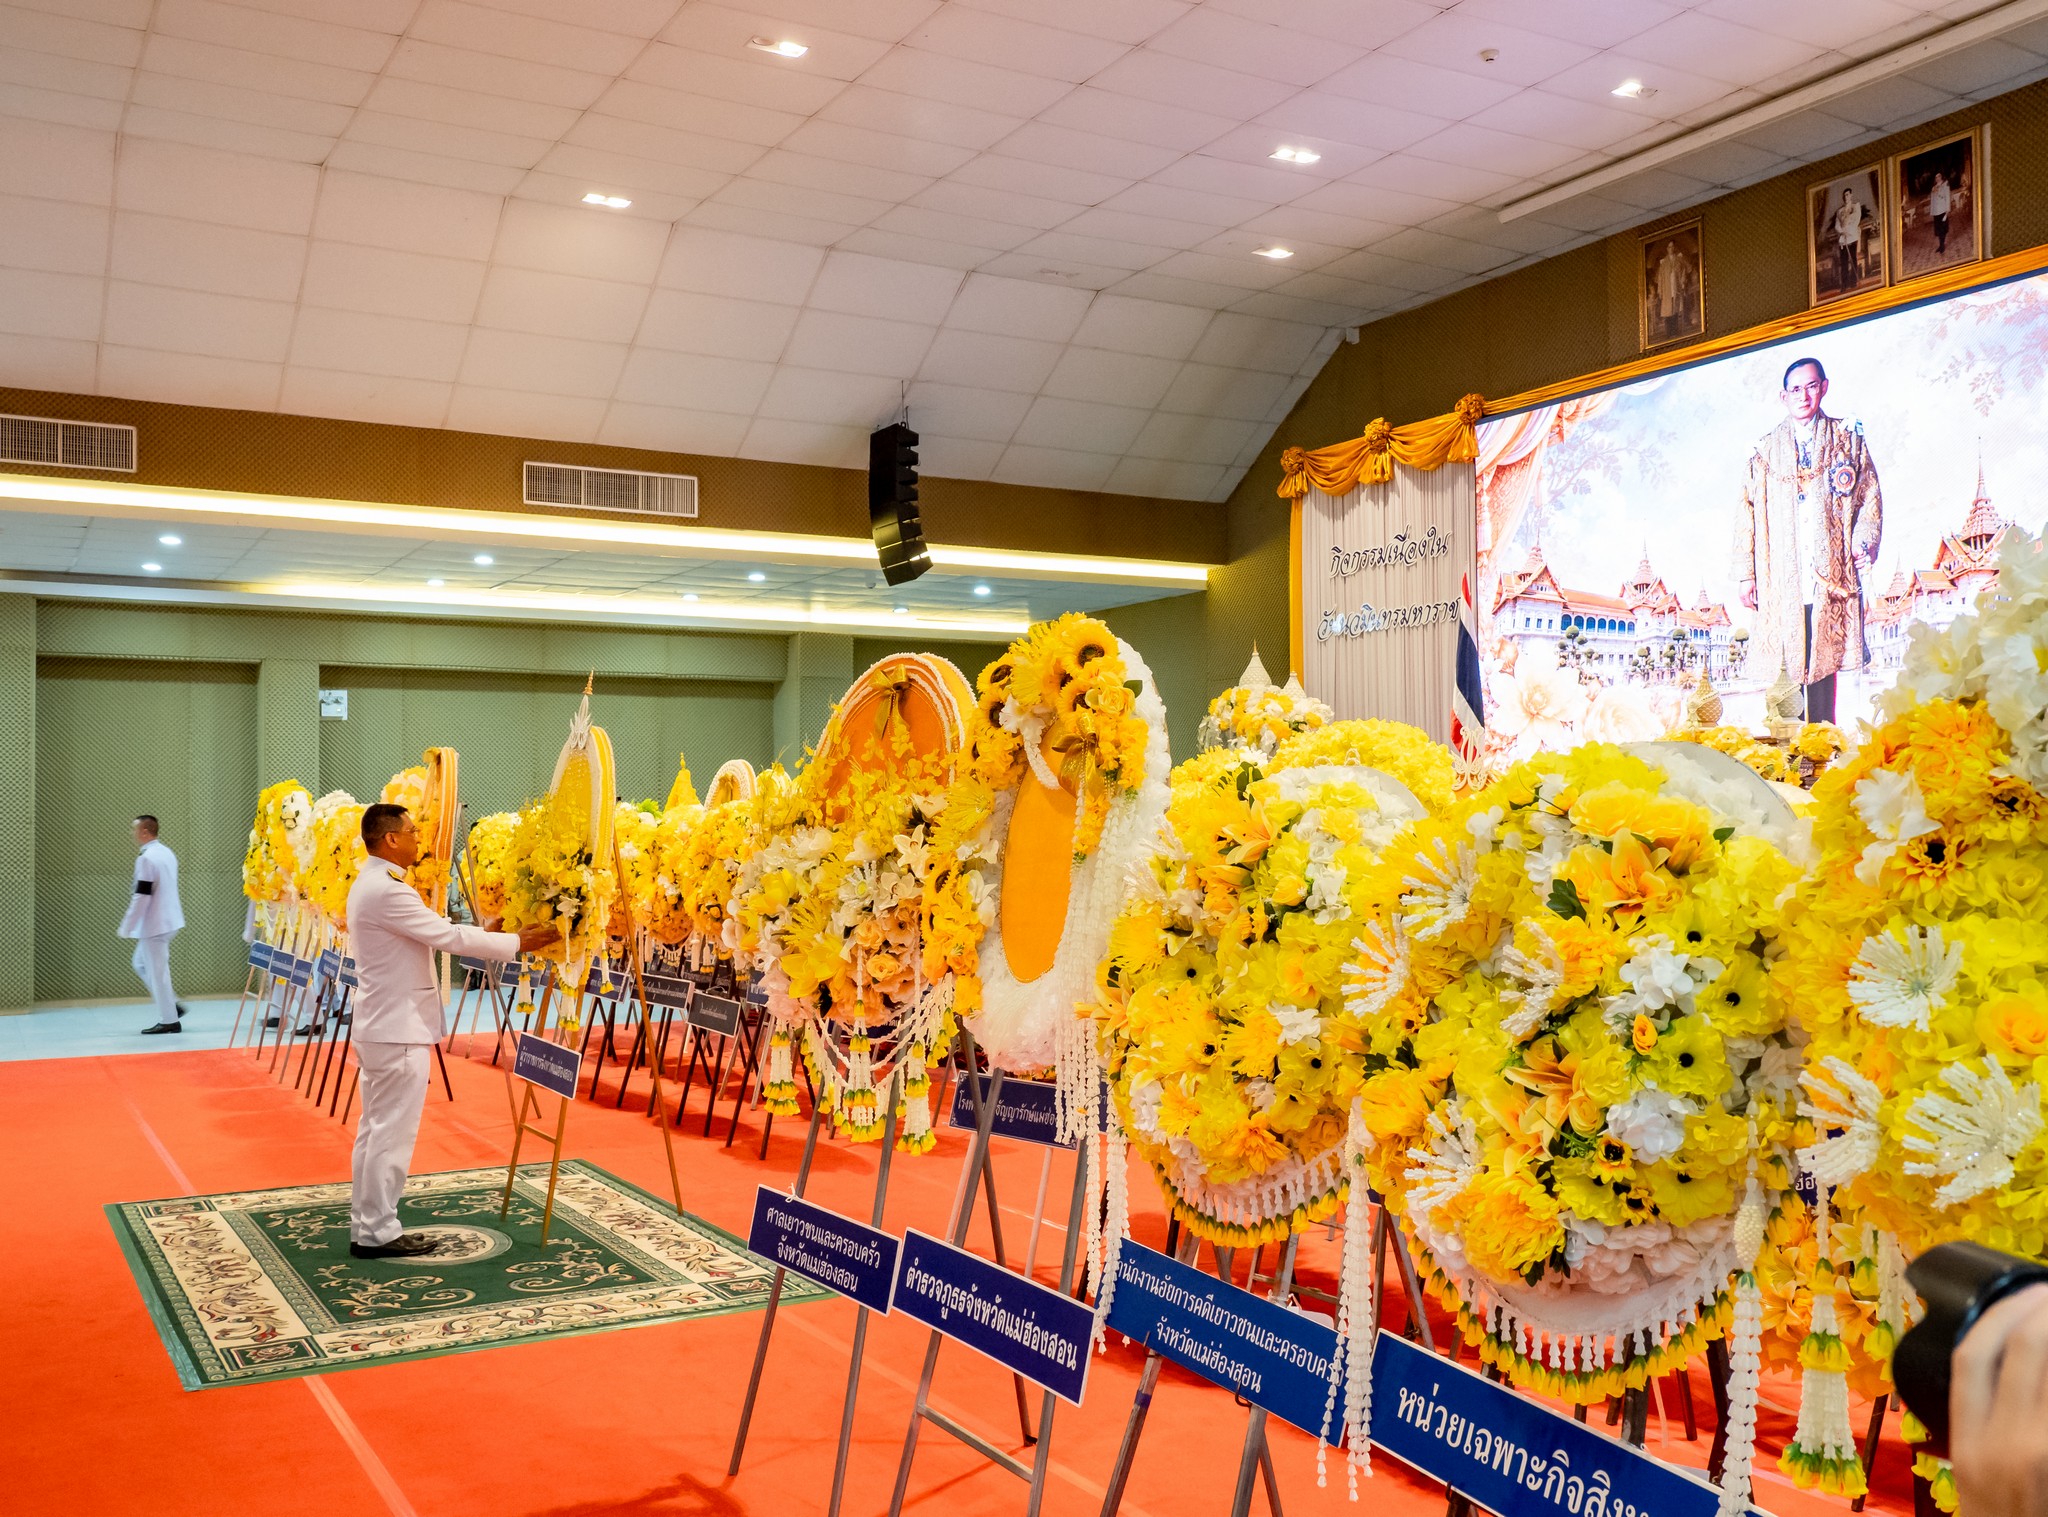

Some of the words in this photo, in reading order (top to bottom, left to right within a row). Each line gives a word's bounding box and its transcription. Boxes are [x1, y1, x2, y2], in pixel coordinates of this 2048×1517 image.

[1330, 525, 1451, 577] กิจกรรมเนื่องใน
[766, 1207, 881, 1269] ศาลเยาวชนและครอบครัว
[777, 1234, 859, 1293] จังหวัดแม่ฮ่องสอน
[905, 1257, 1078, 1371] ตำรวจภูธรจังหวัดแม่ฮ่องสอน
[1156, 1316, 1263, 1394] จังหวัดแม่ฮ่องสอน
